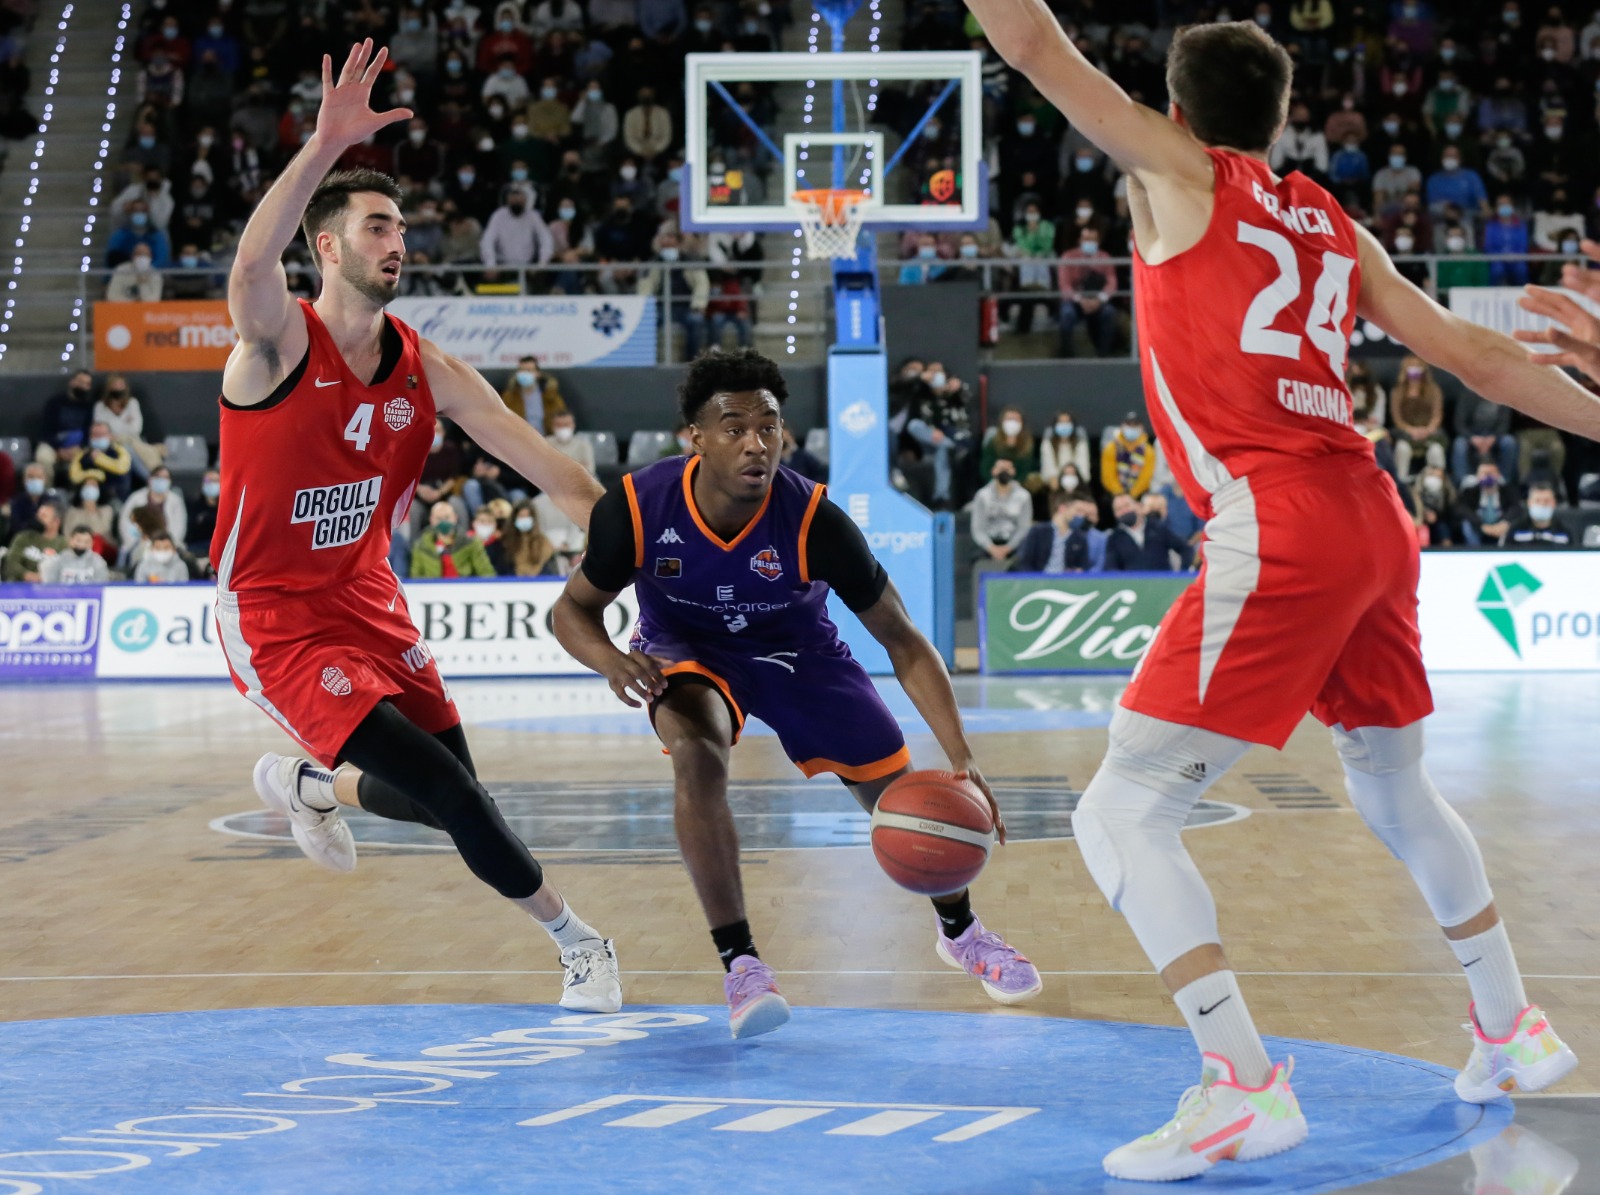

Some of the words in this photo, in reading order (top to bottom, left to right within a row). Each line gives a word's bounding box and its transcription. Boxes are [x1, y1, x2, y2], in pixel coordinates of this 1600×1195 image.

[1252, 181, 1336, 237] FRNCH
[1237, 220, 1356, 382] 24
[384, 414, 411, 425] GIRONA
[386, 407, 411, 416] BASQUET
[1277, 377, 1349, 426] GIRONA
[343, 402, 375, 451] 4
[294, 479, 376, 519] ORGULL
[864, 531, 929, 554] arger
[1531, 611, 1600, 646] pro
